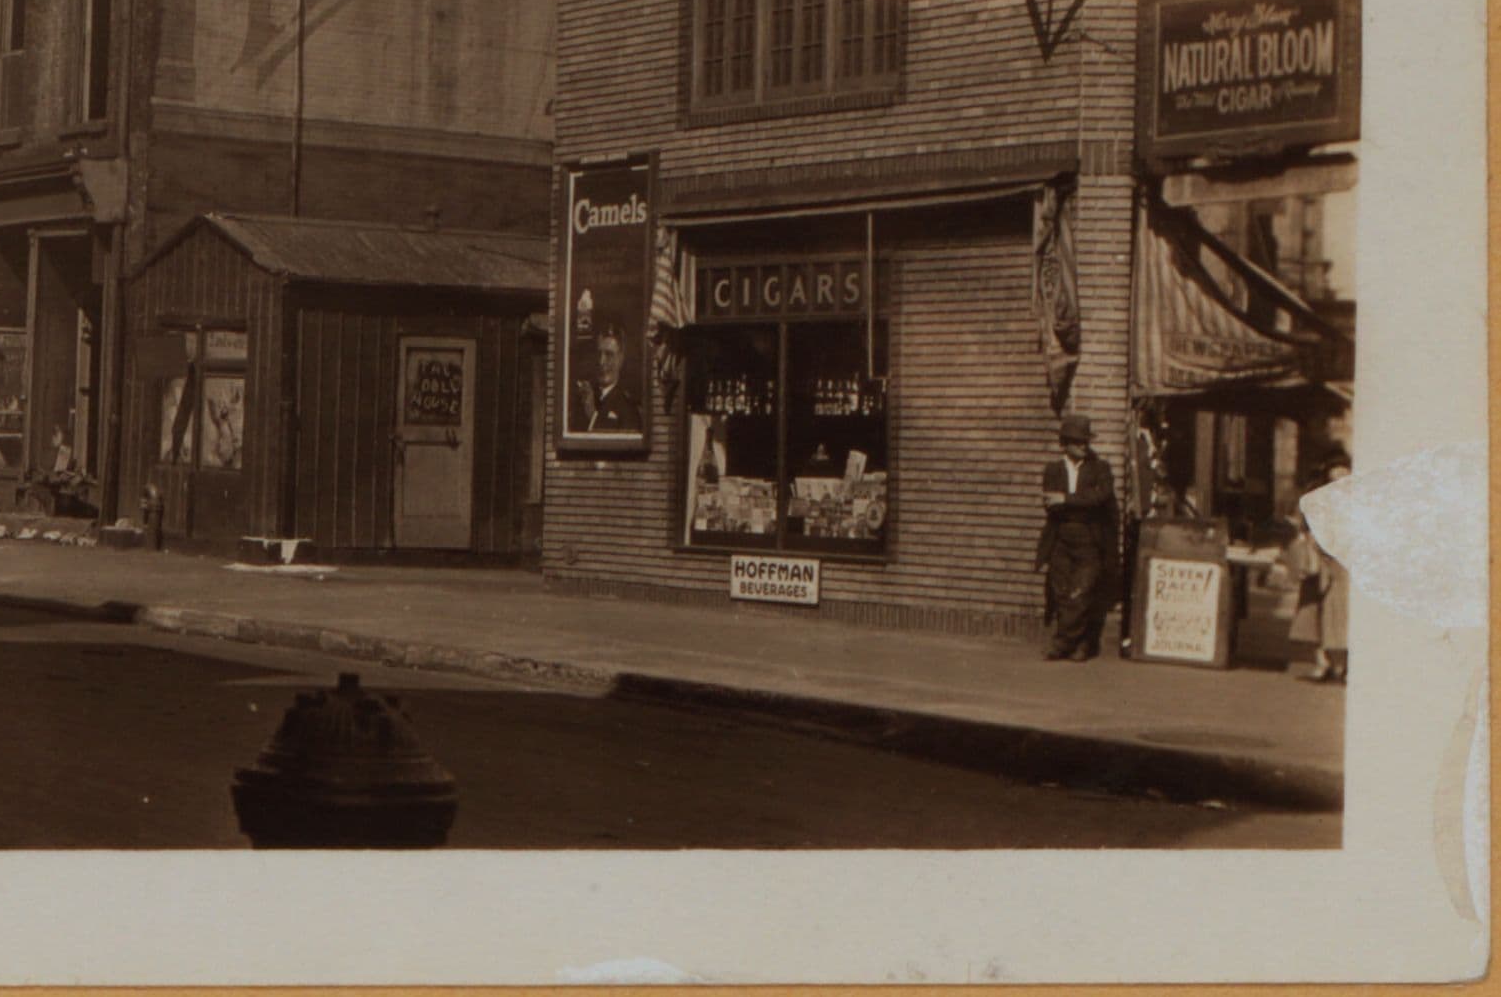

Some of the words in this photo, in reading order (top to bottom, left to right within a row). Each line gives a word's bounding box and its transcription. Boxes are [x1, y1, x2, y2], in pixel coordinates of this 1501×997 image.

[1163, 34, 1255, 94] NATURAL
[1257, 19, 1334, 78] BLOOM
[1217, 83, 1273, 114] CIGAR
[573, 192, 648, 235] Camels
[713, 272, 861, 309] CIGARS
[734, 560, 815, 584] HOFFMAN
[739, 581, 809, 599] BEVERAGES
